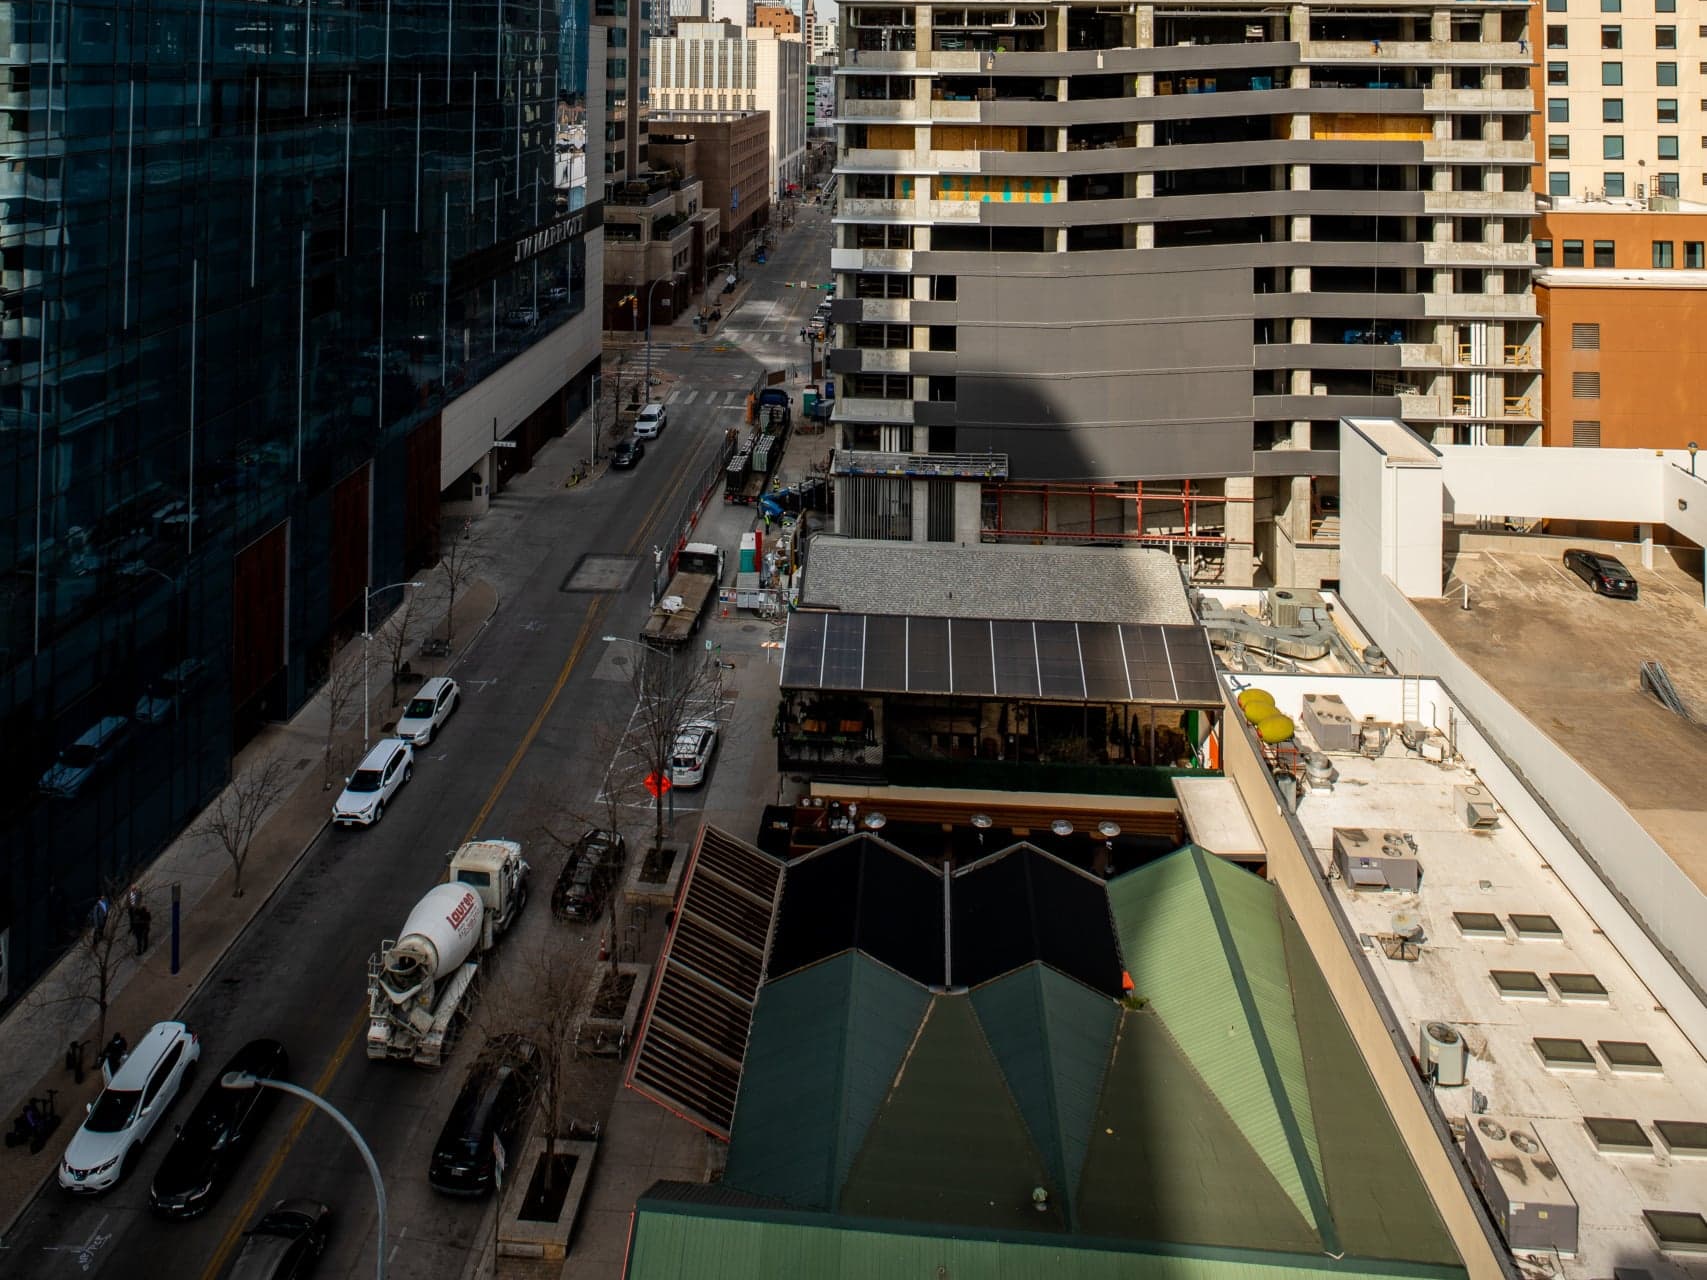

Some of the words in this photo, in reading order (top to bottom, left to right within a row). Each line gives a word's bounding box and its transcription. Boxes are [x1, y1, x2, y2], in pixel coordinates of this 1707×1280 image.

[514, 236, 534, 263] JW
[533, 214, 583, 254] MARRIOTT
[446, 892, 474, 930] Lauren
